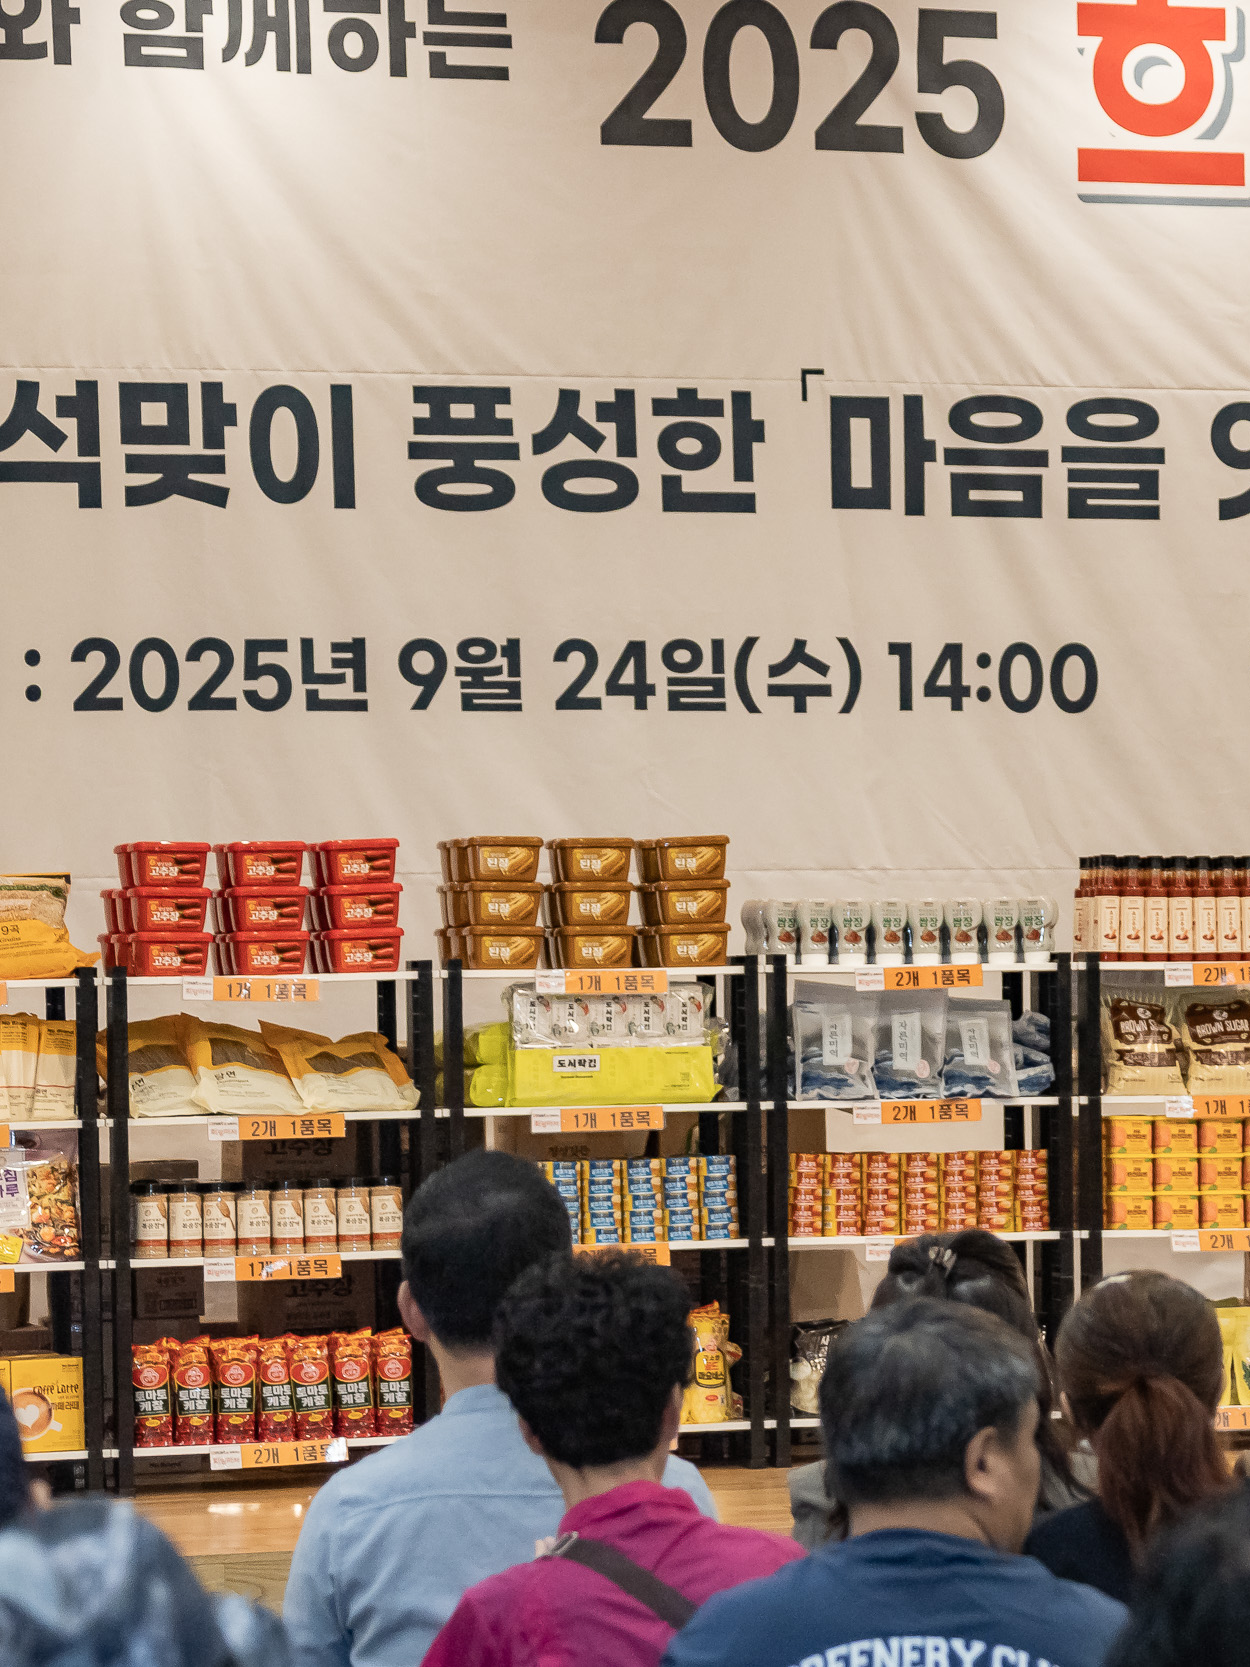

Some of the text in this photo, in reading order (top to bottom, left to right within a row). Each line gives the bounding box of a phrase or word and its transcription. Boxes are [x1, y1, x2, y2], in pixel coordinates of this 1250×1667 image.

[594, 0, 1005, 159] 2025
[0, 379, 357, 511] 석맞이
[407, 386, 767, 514] 풍성한
[70, 637, 370, 713] 2025년
[398, 637, 524, 713] 9월
[552, 636, 863, 715] 24일(수)
[887, 641, 1099, 714] 14:00
[150, 866, 179, 876] 고추장
[247, 865, 276, 876] 고추장
[342, 864, 370, 874] 고추장
[151, 910, 180, 921] 고추장
[249, 910, 278, 920] 고추장
[344, 908, 373, 918] 고추장
[153, 955, 182, 966] 고추장
[251, 955, 280, 965] 고추장
[345, 952, 374, 962] 고추장
[895, 968, 971, 987] 2개 1품목
[1204, 967, 1228, 982] 2개
[578, 974, 655, 991] 1개 1품목
[1120, 1020, 1148, 1034] BROWN
[1196, 1019, 1249, 1037] BROWN SUGAR
[557, 1058, 597, 1069] 도시락김
[892, 1104, 970, 1121] 2개 1품목
[1205, 1099, 1227, 1115] 1개
[574, 1111, 650, 1128] 1개 1품목
[251, 1118, 332, 1136] 2개 1품목
[1210, 1234, 1234, 1249] 2개
[220, 1387, 252, 1398] 토마토
[262, 1385, 291, 1397] 토마토
[296, 1384, 329, 1398] 토마토
[337, 1382, 369, 1394] 토마토
[380, 1381, 411, 1392] 토마토
[135, 1389, 168, 1401] 토마토
[179, 1388, 211, 1400] 토마토
[1216, 1416, 1230, 1428] 개
[253, 1448, 279, 1465] 2개
